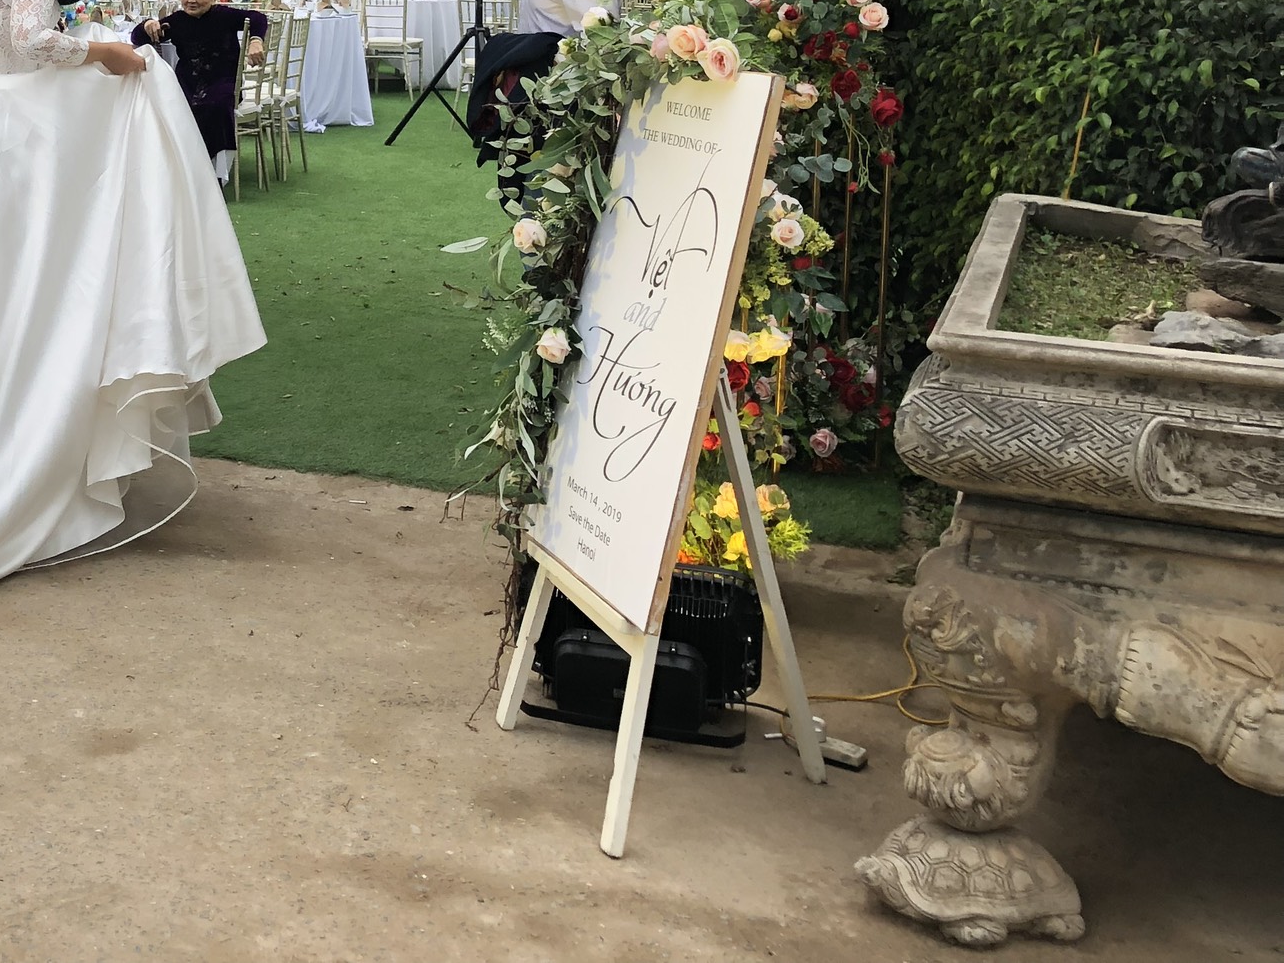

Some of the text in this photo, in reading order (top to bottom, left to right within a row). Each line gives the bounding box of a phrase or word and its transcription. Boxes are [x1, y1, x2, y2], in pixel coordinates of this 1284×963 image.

[666, 101, 713, 122] WELCOME
[642, 128, 719, 155] THE WEDDING OF
[623, 297, 668, 331] and
[567, 475, 589, 501] March
[602, 501, 622, 523] 2019
[568, 505, 611, 547] Save the Date
[577, 537, 597, 562] Hanoi
